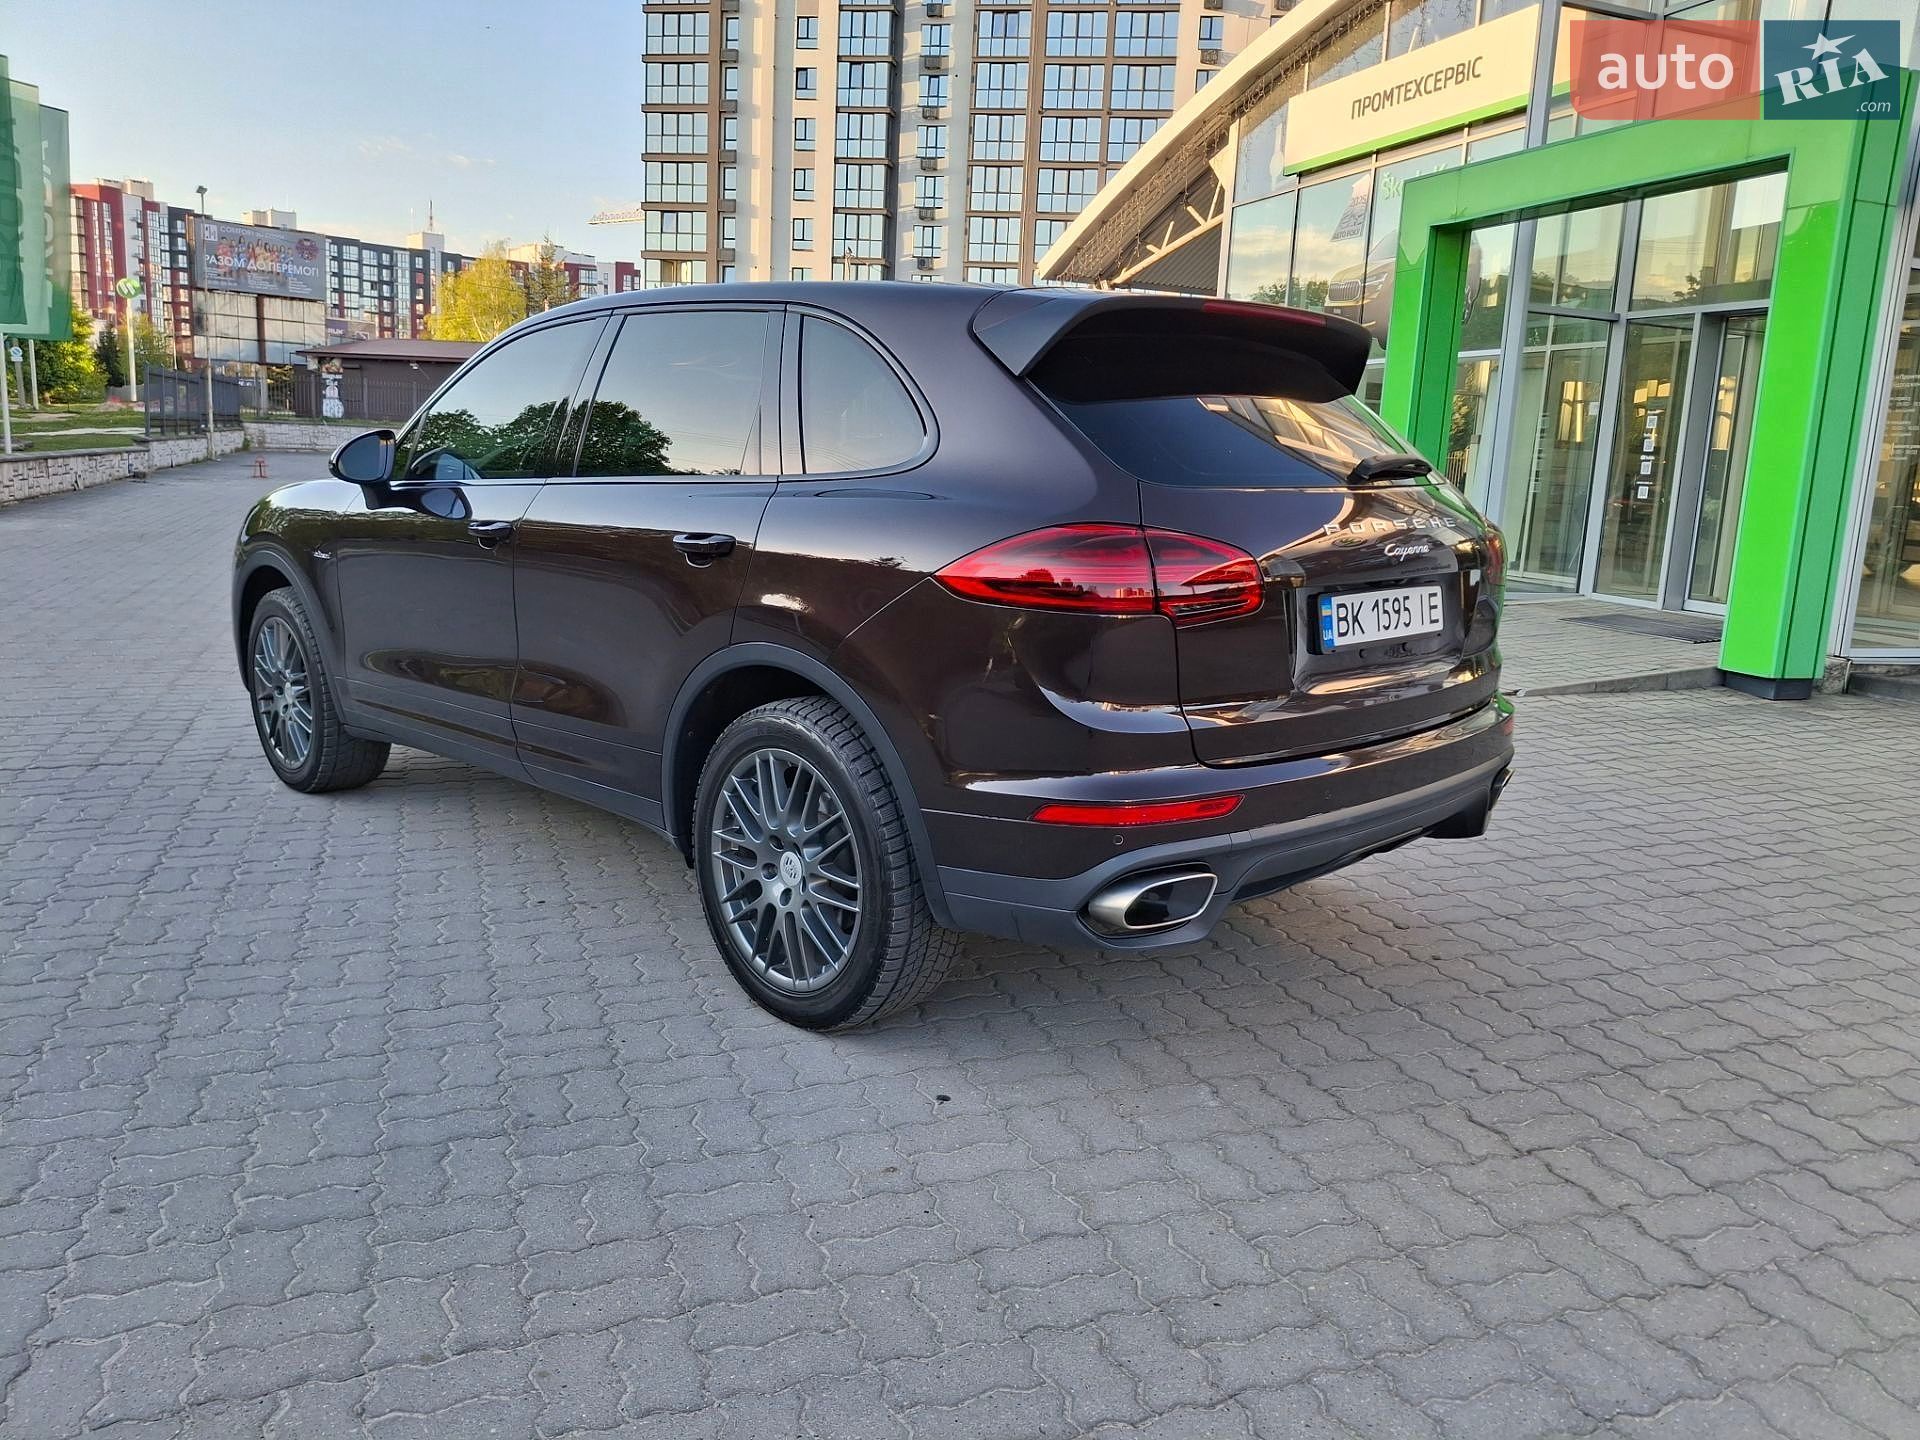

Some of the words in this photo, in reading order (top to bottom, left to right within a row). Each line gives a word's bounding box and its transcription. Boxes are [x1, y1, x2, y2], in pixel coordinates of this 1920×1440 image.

[1351, 56, 1483, 120] ПРОМТЕХСЕРВІС
[205, 253, 245, 267] РАЗОМ
[247, 260, 266, 271] ДО
[1323, 516, 1457, 536] PORSCHE
[1384, 543, 1430, 561] Cayenne
[1336, 601, 1365, 638] BK
[1372, 594, 1413, 633] 1595
[1420, 592, 1440, 626] IE
[1323, 629, 1334, 641] UA
